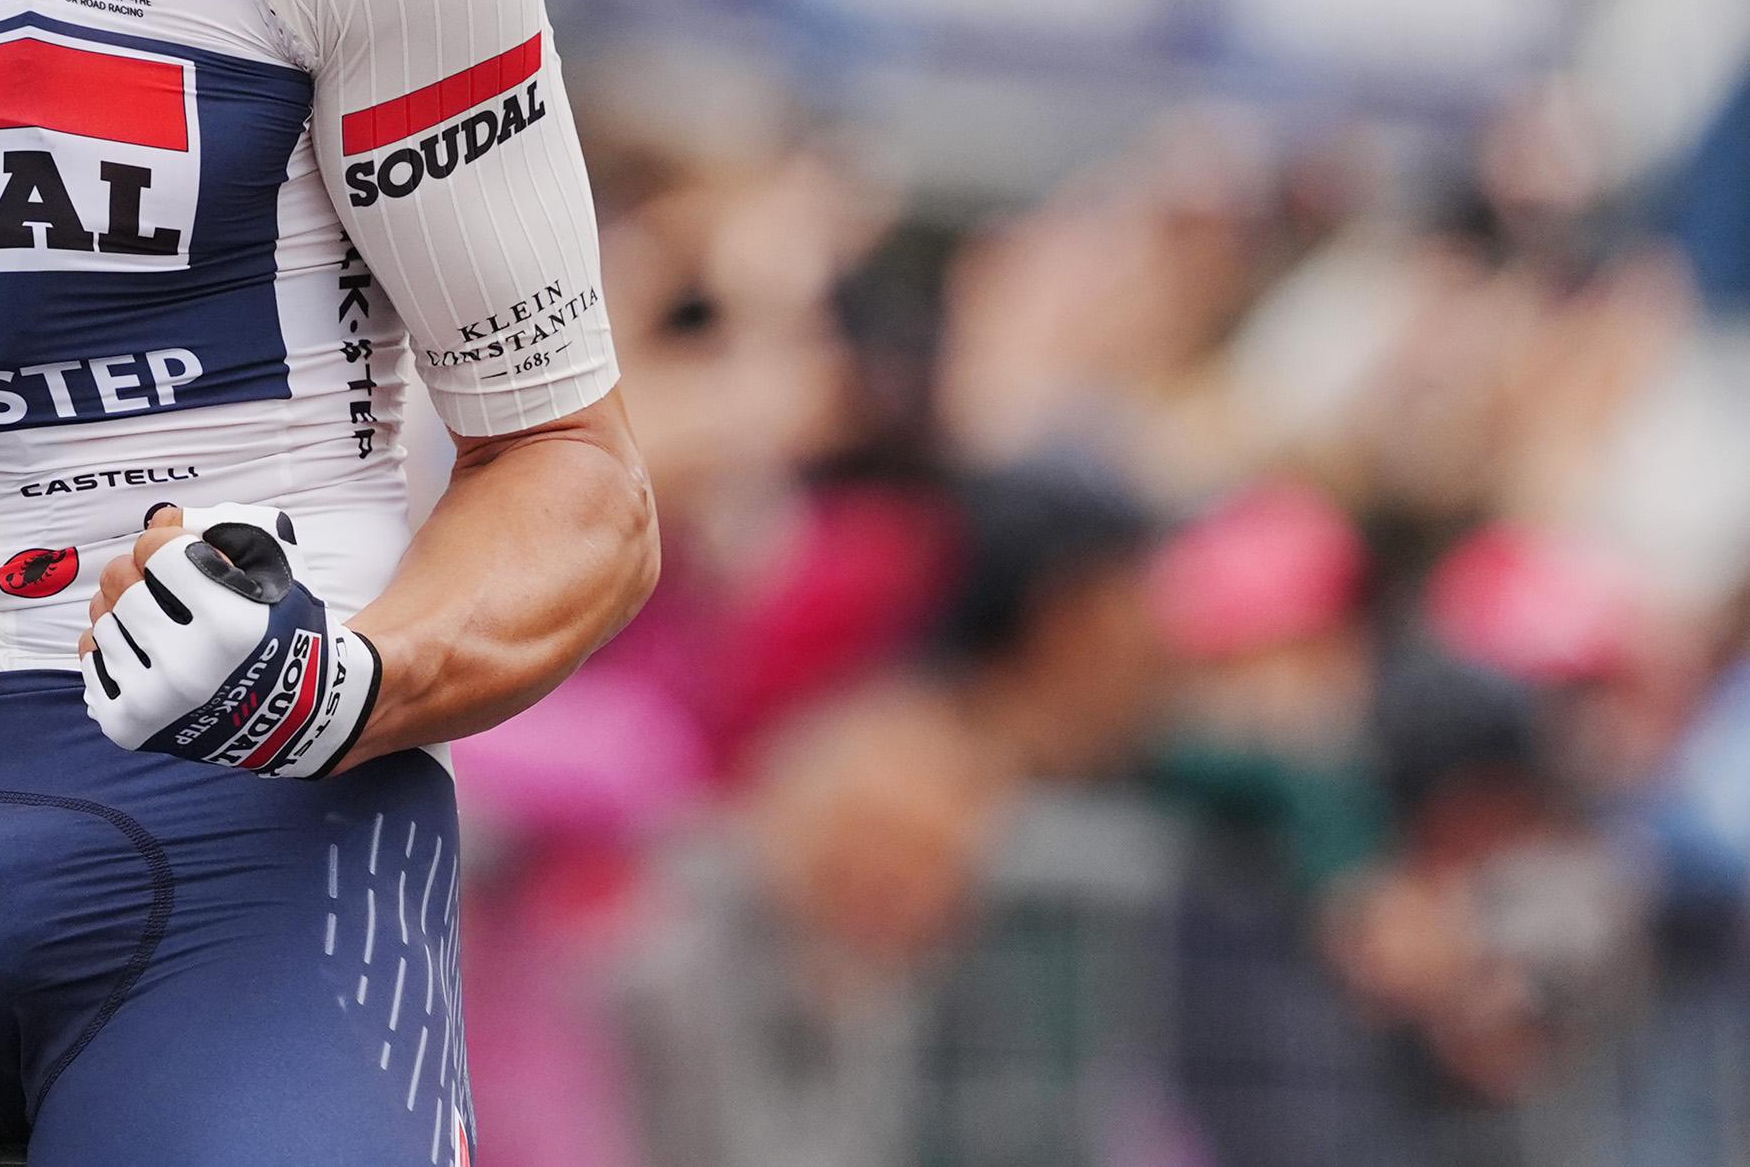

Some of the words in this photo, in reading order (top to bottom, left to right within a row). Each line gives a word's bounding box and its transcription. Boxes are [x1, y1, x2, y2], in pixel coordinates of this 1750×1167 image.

[108, 3, 144, 18] RACING
[344, 80, 546, 207] SOUDAL
[426, 285, 598, 366] CONSTANTIA
[458, 279, 563, 343] KLEIN
[514, 352, 551, 375] 1685
[21, 467, 199, 497] CASTELLI
[207, 632, 309, 764] SOUDAL
